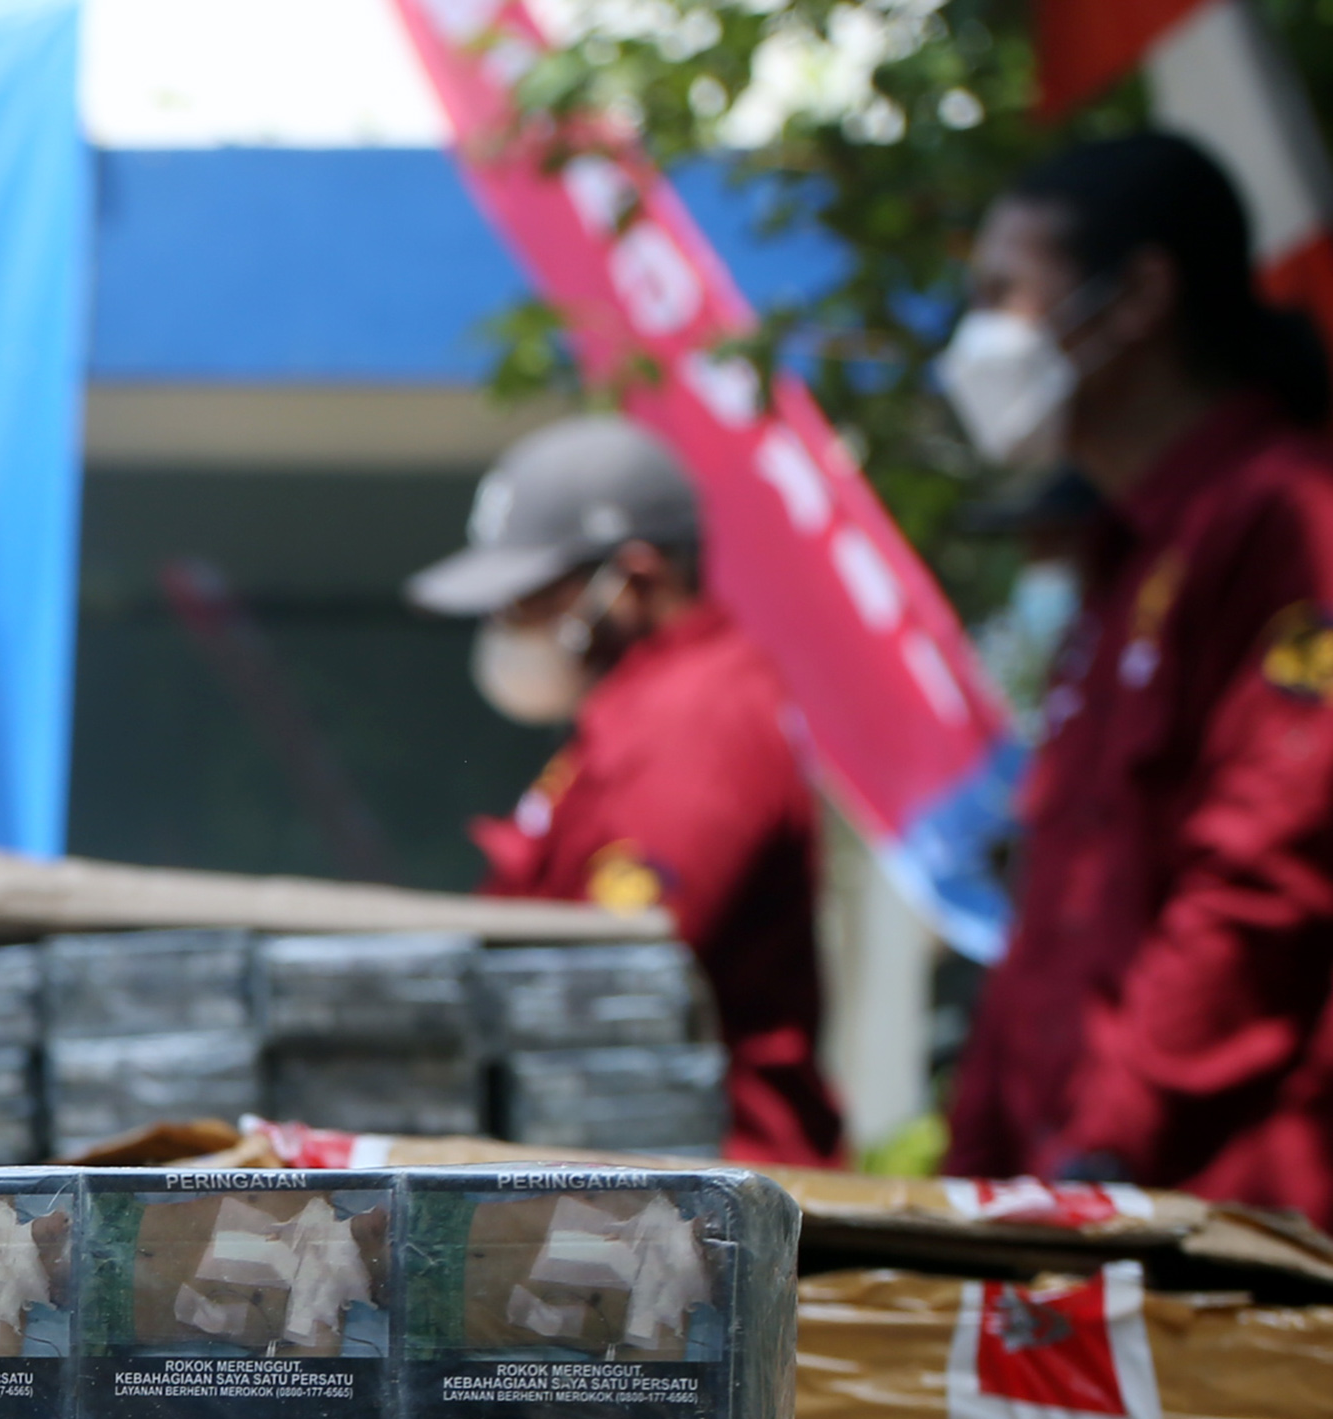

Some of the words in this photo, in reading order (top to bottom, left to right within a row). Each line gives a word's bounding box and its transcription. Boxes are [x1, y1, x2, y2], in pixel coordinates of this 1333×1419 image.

[166, 1173, 307, 1190] PERINGATAN
[497, 1173, 647, 1190] PERINGATAN
[165, 1361, 213, 1372] ROKOK
[497, 1364, 548, 1376] ROKOK
[115, 1373, 212, 1384] KEBAHAGIAAN
[217, 1373, 250, 1385] SAYA
[253, 1374, 288, 1385] SATU
[292, 1374, 353, 1385] PERSATU
[444, 1377, 547, 1389] KEBAHAGIAAN
[551, 1377, 587, 1389] SAYA
[591, 1378, 628, 1390] SATU
[632, 1378, 698, 1390] PERSATU
[115, 1386, 162, 1396] LAYANAN
[165, 1386, 217, 1396] BERHENTI
[220, 1386, 272, 1397] MEROKOK
[443, 1391, 494, 1400] LAYANAN
[497, 1391, 553, 1401] BERHENTI
[556, 1392, 612, 1402] MEROKOK
